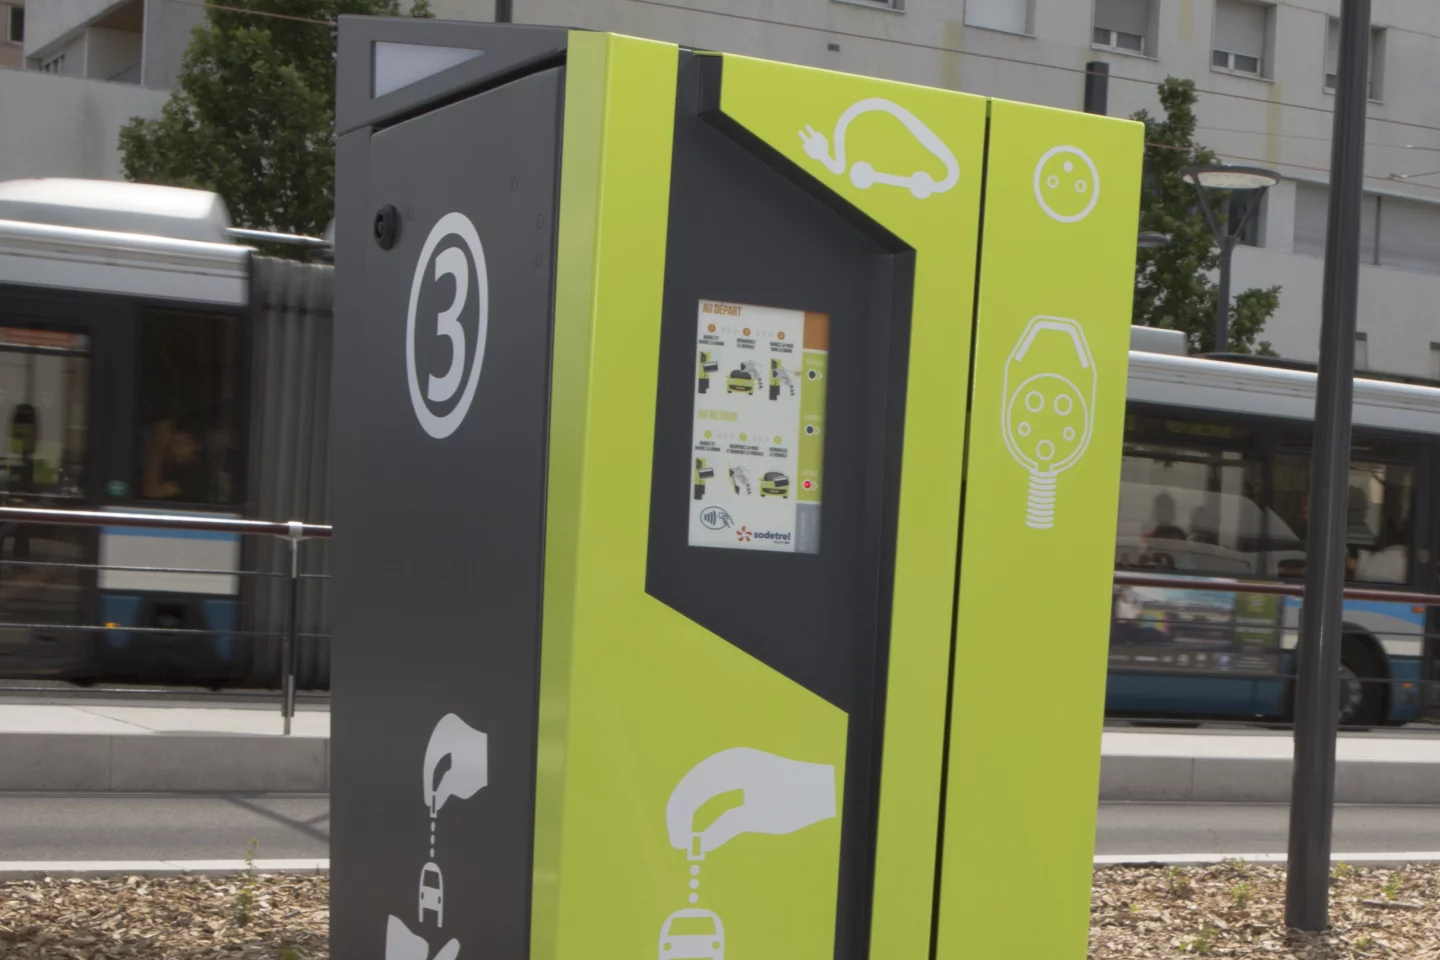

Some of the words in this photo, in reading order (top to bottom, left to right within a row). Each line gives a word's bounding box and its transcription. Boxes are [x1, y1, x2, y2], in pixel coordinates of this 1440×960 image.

[702, 302, 712, 313] AU
[714, 302, 743, 317] DÉPART
[428, 247, 469, 402] 3
[753, 530, 791, 541] sodetrel
